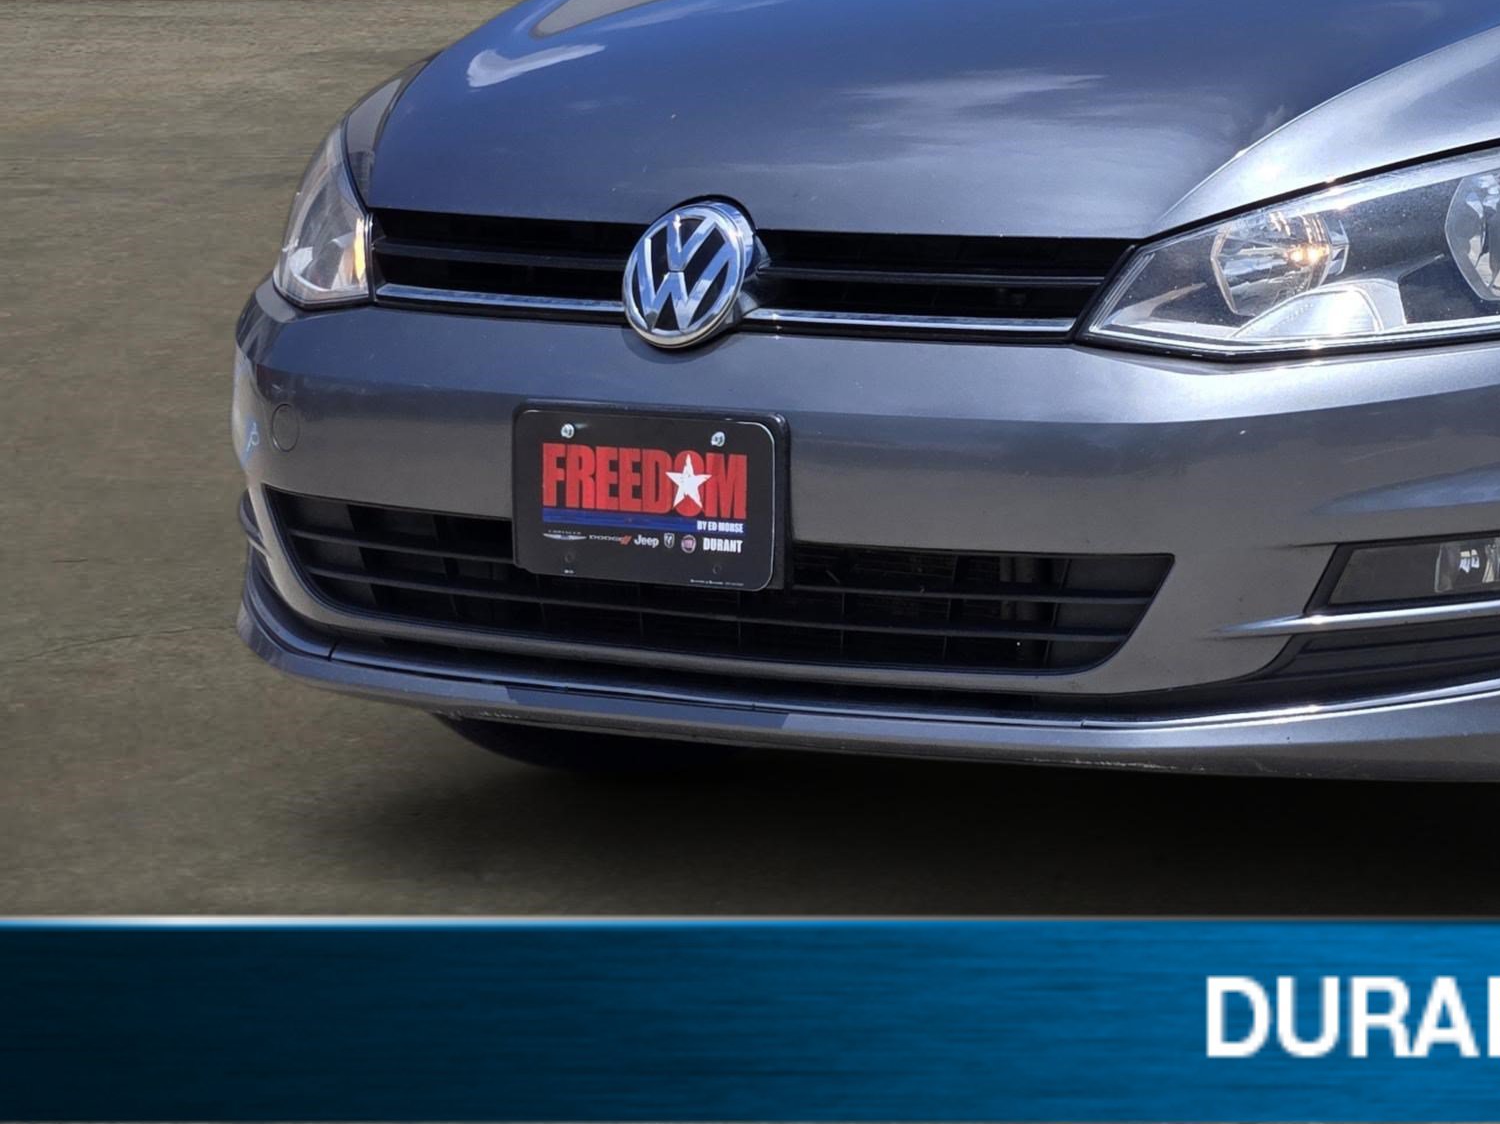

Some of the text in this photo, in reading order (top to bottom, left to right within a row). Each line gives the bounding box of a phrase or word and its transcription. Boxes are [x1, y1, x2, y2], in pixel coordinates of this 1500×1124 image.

[630, 210, 738, 337] VW
[696, 520, 744, 533] BY ED MORSE
[634, 534, 659, 548] Jeep
[703, 537, 743, 553] DURANT
